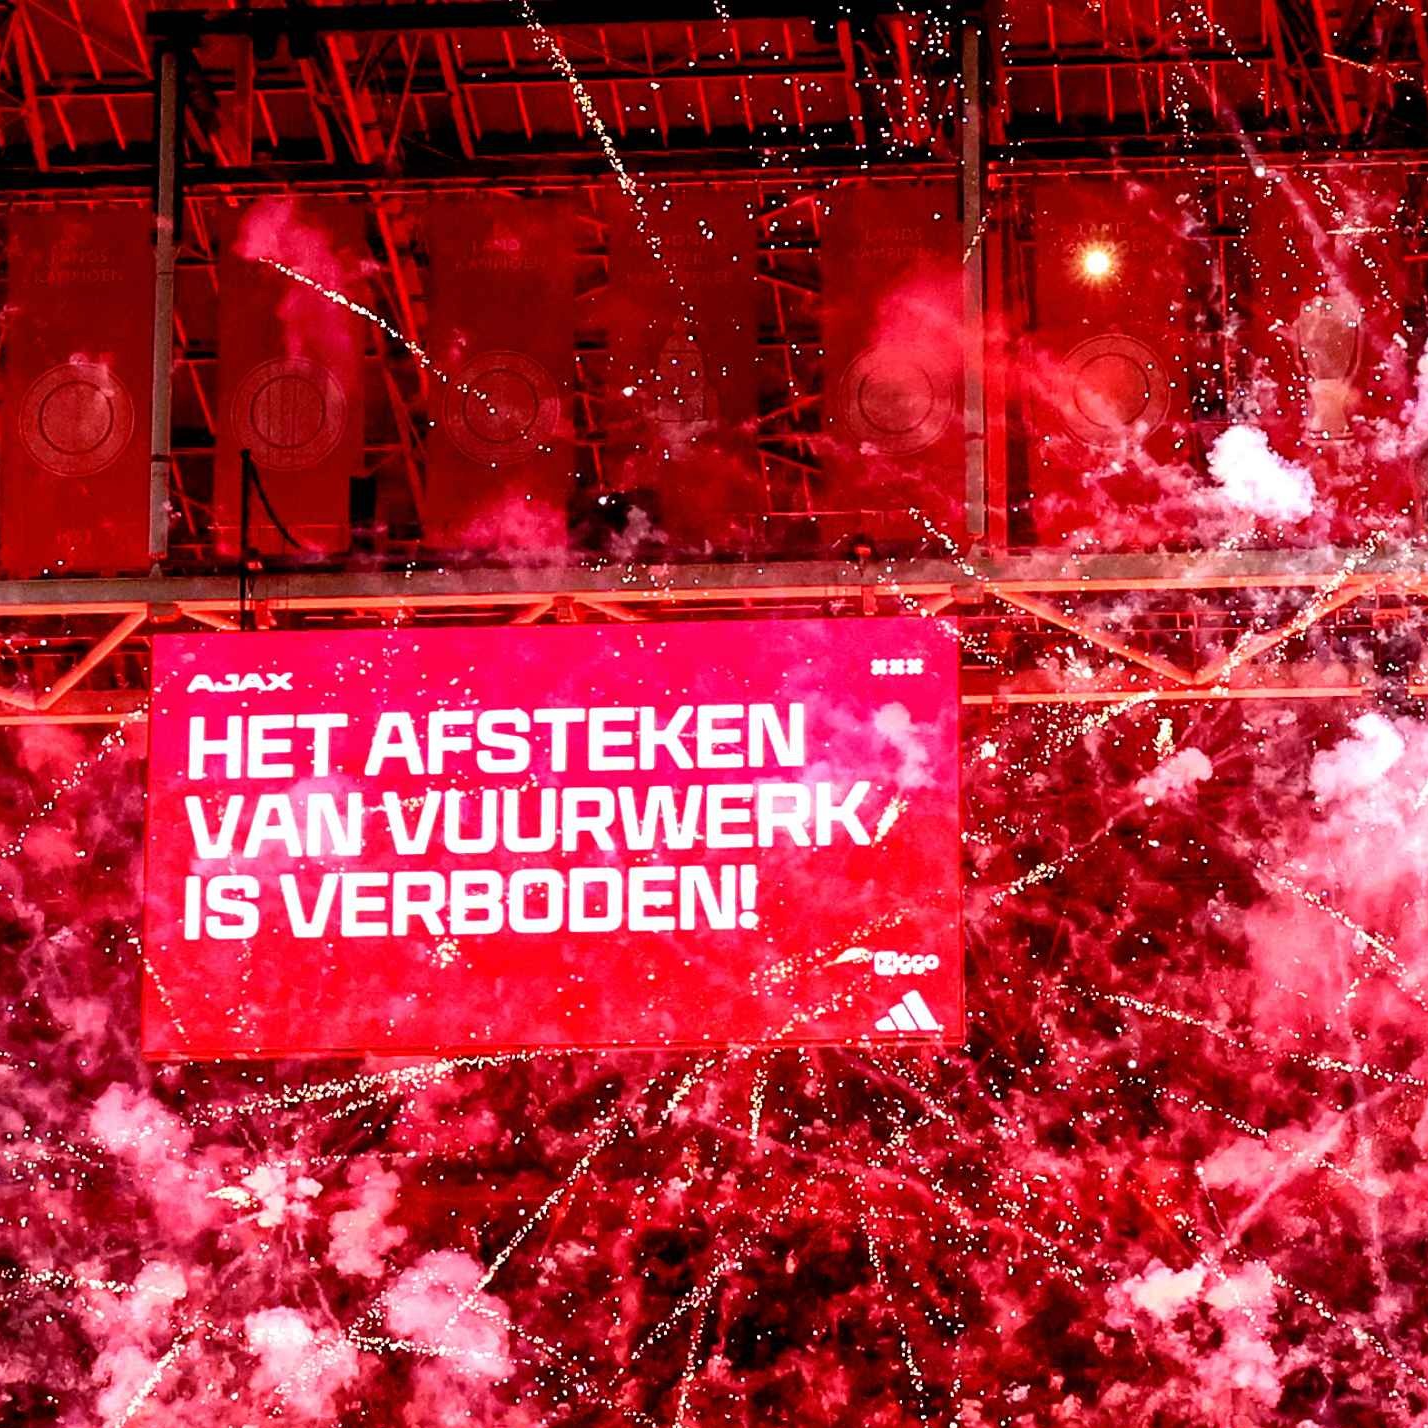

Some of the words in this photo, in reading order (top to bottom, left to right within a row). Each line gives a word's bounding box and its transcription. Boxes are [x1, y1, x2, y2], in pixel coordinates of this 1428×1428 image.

[186, 672, 293, 693] AJAX
[187, 713, 348, 779] HET
[364, 703, 805, 777] AFSTEKEN
[183, 792, 364, 859] VAN
[384, 780, 872, 855] VUURWERK
[184, 873, 260, 941] IS
[280, 864, 760, 938] VERBODEN!
